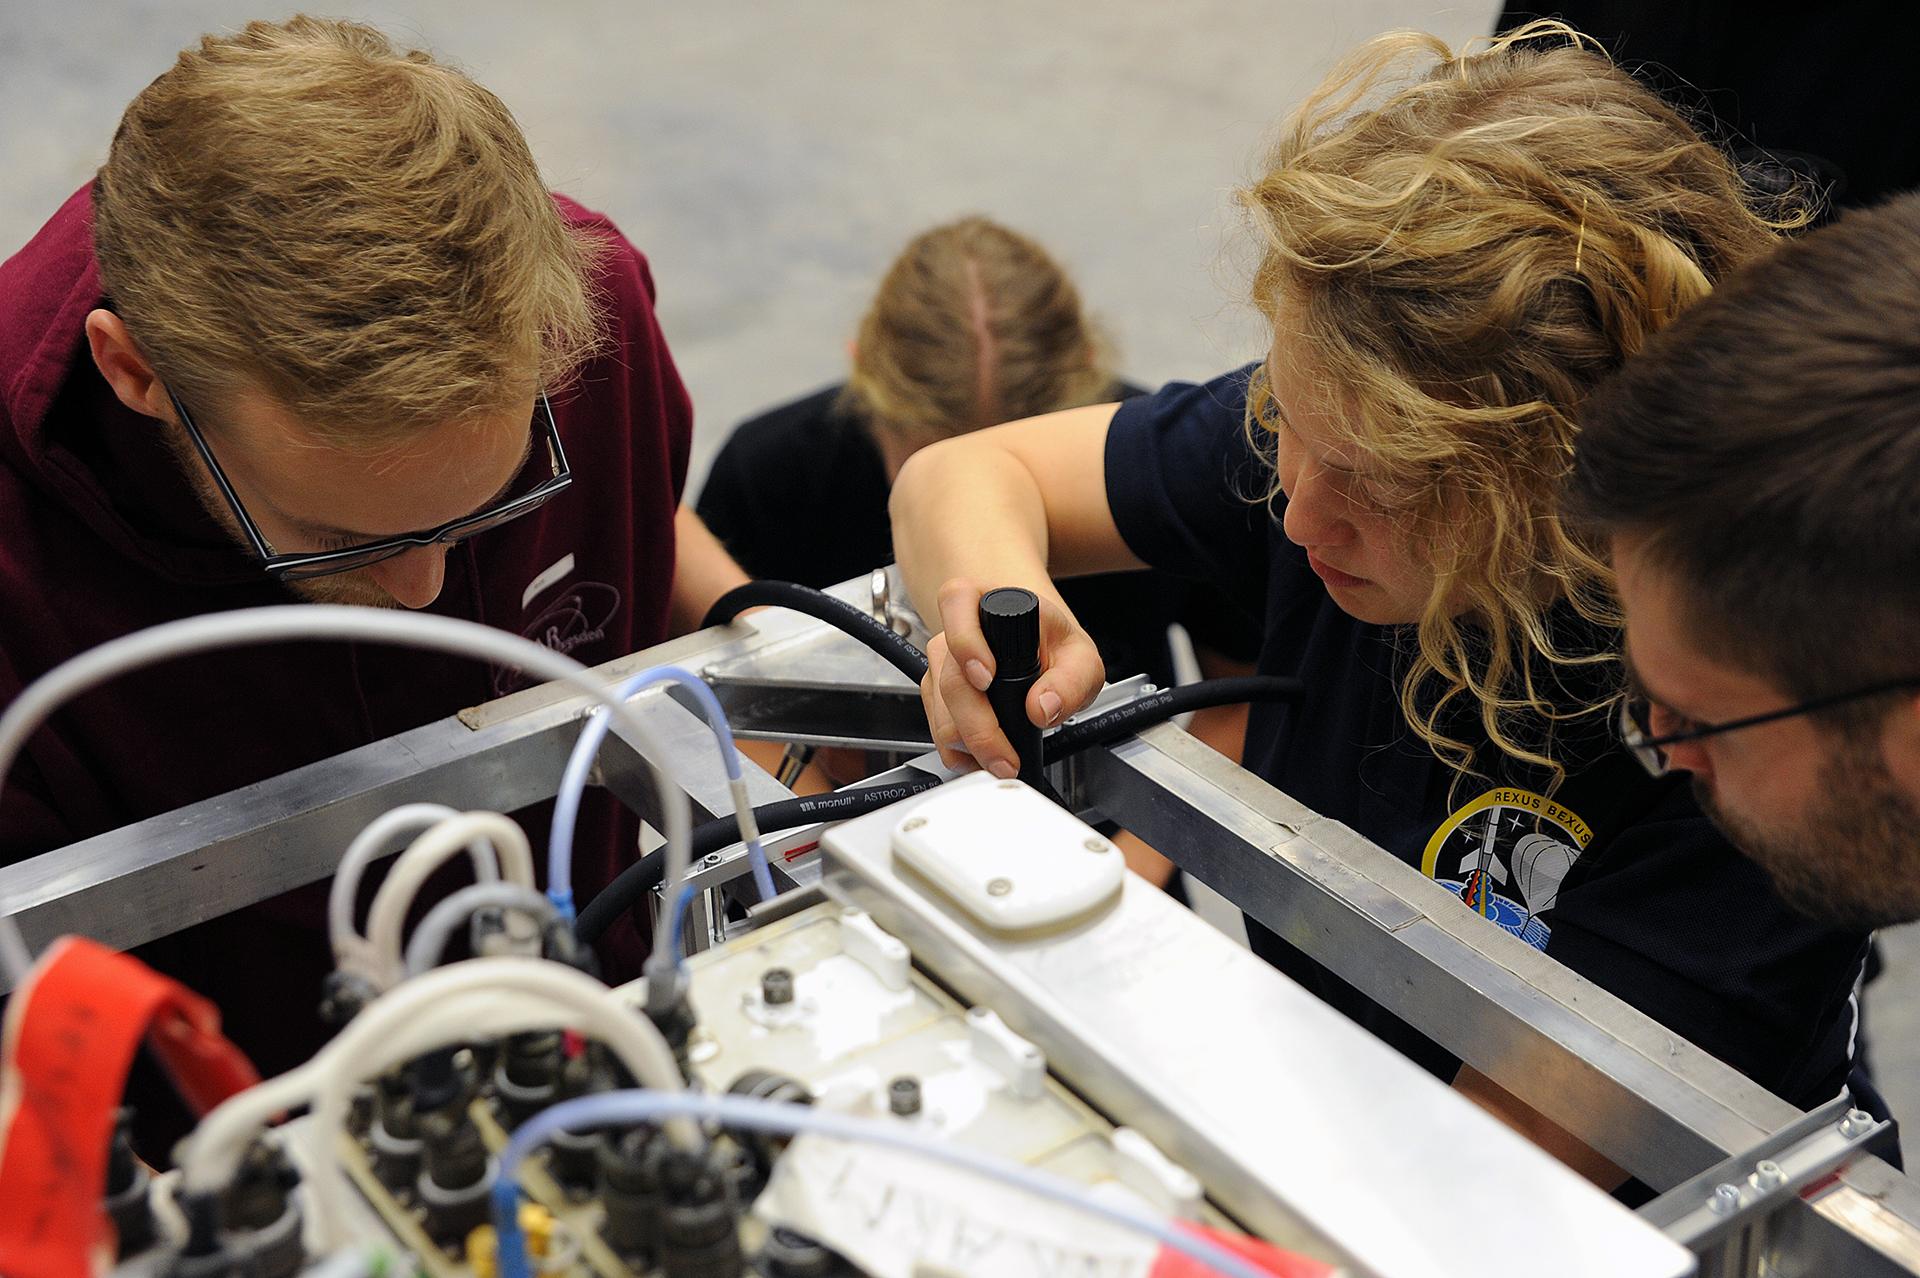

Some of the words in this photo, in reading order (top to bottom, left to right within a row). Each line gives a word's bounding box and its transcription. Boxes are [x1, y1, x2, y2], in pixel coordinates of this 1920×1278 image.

[904, 644, 921, 657] ISO
[1091, 719, 1108, 730] WP
[1110, 713, 1121, 723] 75
[1122, 707, 1137, 718] bar
[1138, 700, 1159, 712] 1080
[864, 788, 906, 802] ASTRO/2
[1494, 791, 1540, 809] REXUS
[1547, 805, 1591, 843] BEXUS
